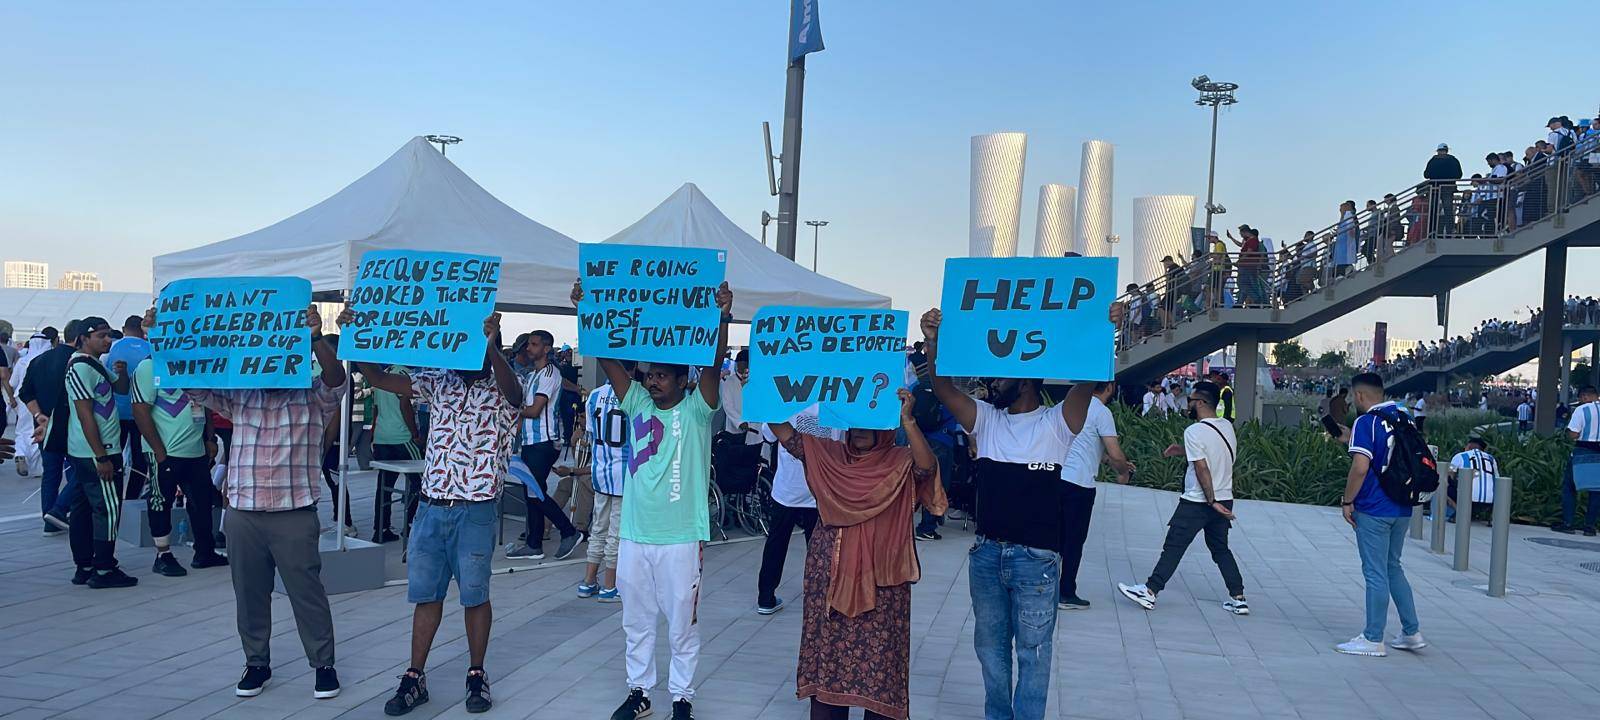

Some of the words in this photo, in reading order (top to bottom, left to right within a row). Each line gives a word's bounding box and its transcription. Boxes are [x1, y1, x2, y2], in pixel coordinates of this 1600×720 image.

[586, 260, 619, 277] WE
[630, 259, 642, 277] R
[646, 260, 698, 278] GOING
[160, 293, 194, 313] WE
[205, 289, 277, 309] WANT
[352, 285, 425, 306] BOOKED
[590, 287, 679, 306] THROUGH
[960, 277, 1096, 311] HELP
[158, 318, 186, 337] TO
[190, 309, 308, 334] CELEBRATE
[346, 310, 379, 328] OR
[381, 308, 449, 327] LUSAIL
[580, 307, 643, 332] WORSE
[755, 315, 791, 334] MY
[795, 314, 896, 334] DAUGTER
[150, 335, 198, 352] THIS
[201, 334, 264, 349] WORLD
[267, 335, 302, 350] CUP
[608, 325, 719, 349] SITUATION
[757, 332, 814, 356] WAS
[821, 336, 907, 353] DEPORTED
[987, 329, 1047, 362] US
[167, 357, 228, 376] WITH
[239, 354, 304, 375] HER
[600, 396, 620, 406] MESS
[592, 407, 628, 449] 10
[1027, 462, 1055, 471] GAS
[1469, 456, 1495, 475] 10
